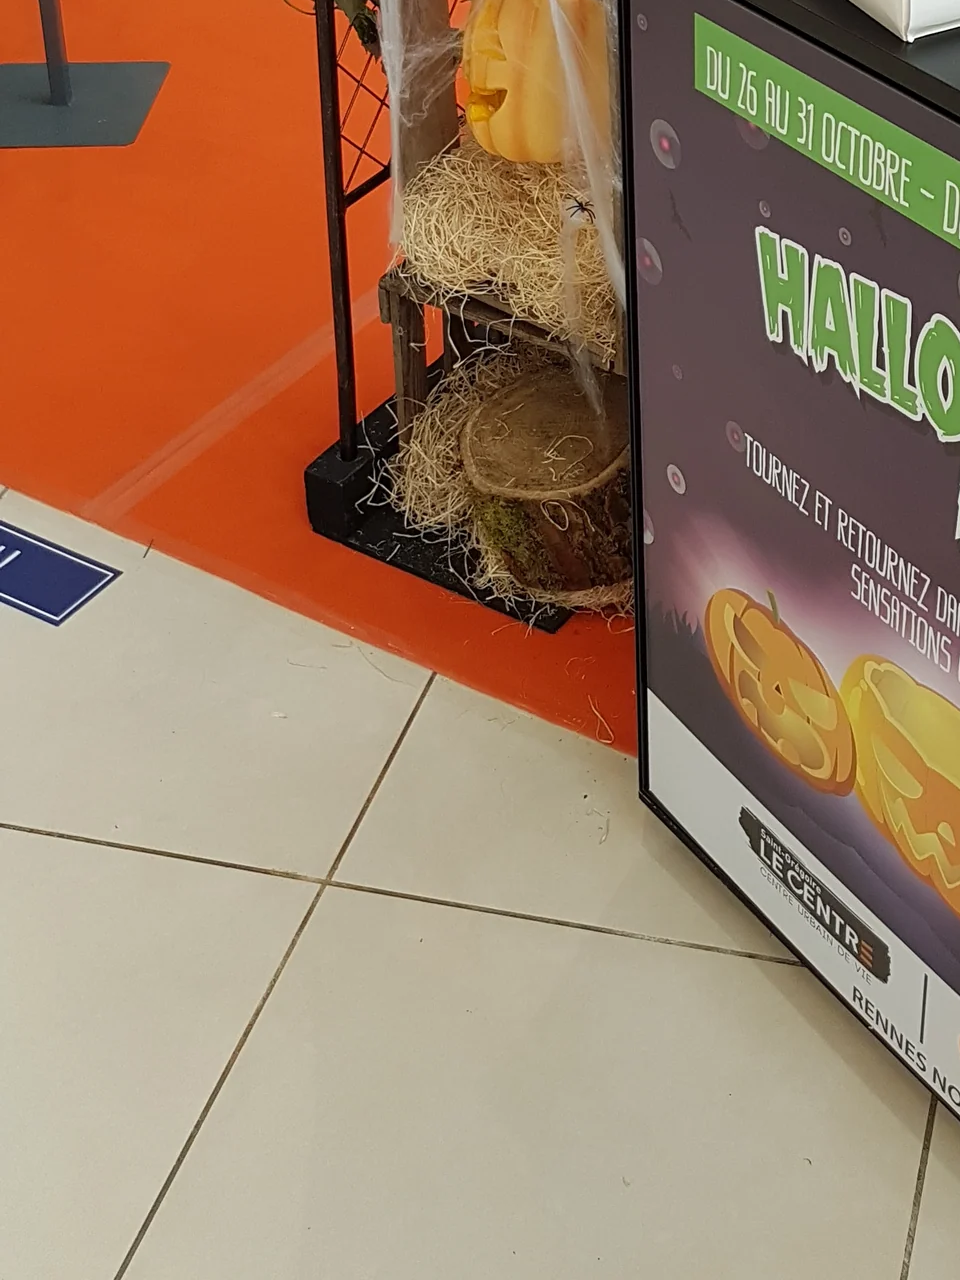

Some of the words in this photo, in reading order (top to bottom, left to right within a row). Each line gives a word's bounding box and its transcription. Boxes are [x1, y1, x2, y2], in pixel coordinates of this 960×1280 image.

[706, 45, 731, 101] DU
[737, 62, 758, 116] 26
[765, 78, 790, 136] AU
[796, 96, 815, 151] 31
[820, 112, 913, 208] OCTOBRE
[744, 432, 810, 516] TOURNEZ
[814, 490, 833, 532] ET
[836, 508, 932, 612] RETOURNEZ
[850, 563, 952, 674] SENSATIONS
[760, 828, 822, 895] Saint-Grégoire
[759, 866, 794, 907] CENTRE
[797, 904, 834, 948] URBAIN
[837, 946, 851, 965] DE
[853, 961, 872, 986] VIE
[852, 984, 927, 1073] RENNES
